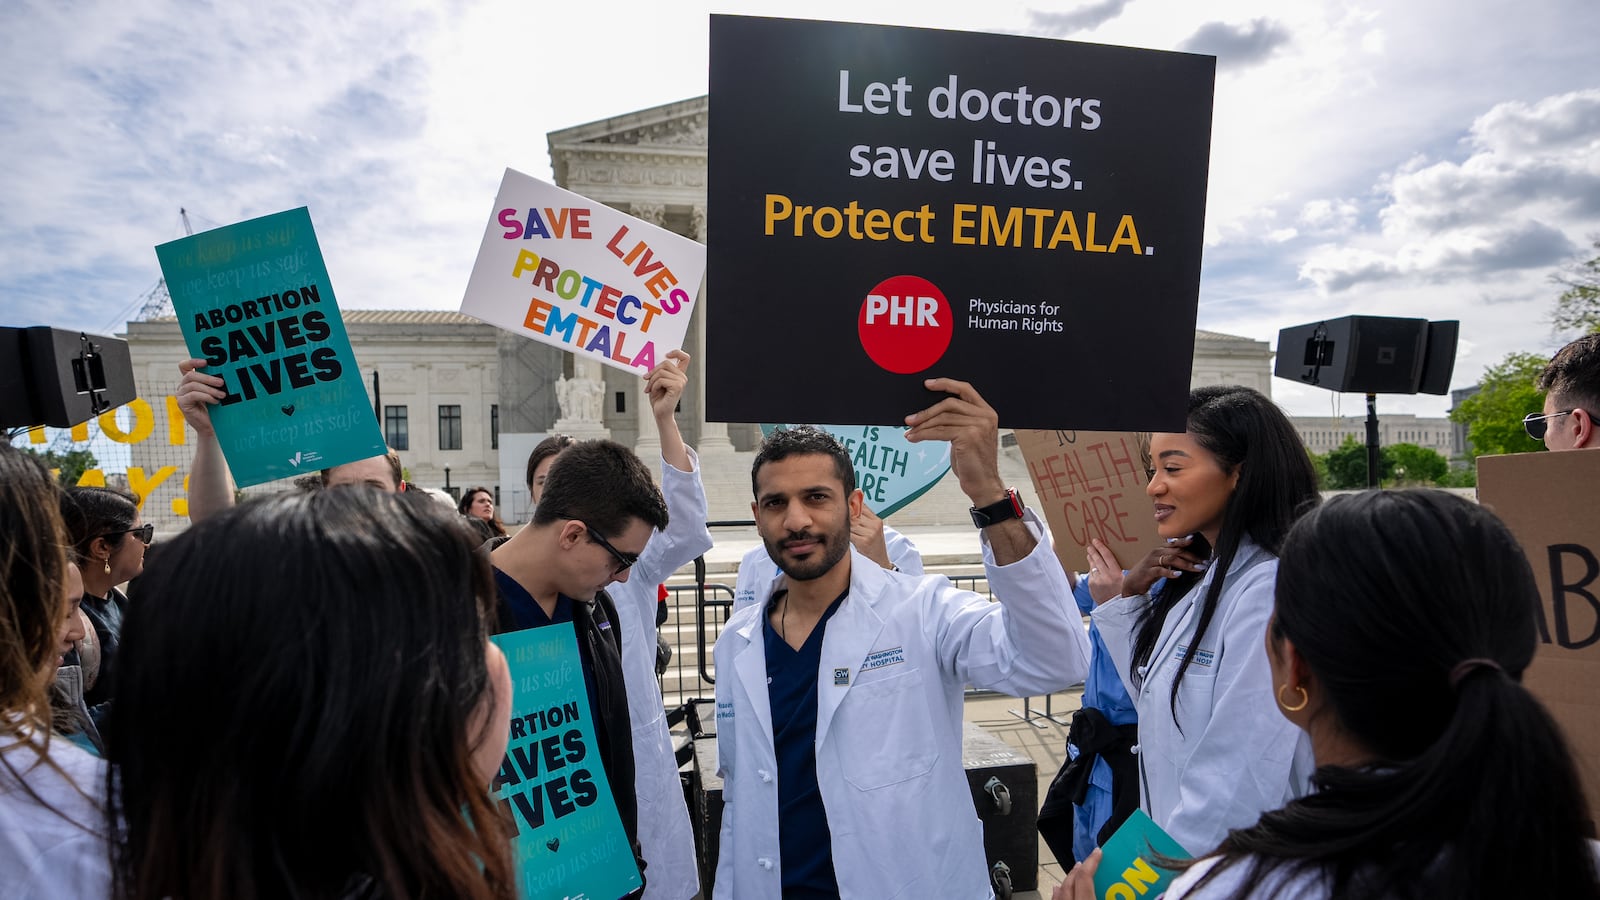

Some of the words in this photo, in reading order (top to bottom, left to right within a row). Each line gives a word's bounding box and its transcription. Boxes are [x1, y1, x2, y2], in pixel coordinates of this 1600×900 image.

[839, 70, 912, 117] Let
[928, 75, 1102, 131] doctors
[849, 144, 955, 182] save
[972, 140, 1083, 190] lives.
[498, 208, 592, 239] SAVE
[765, 194, 935, 243] Protect
[952, 204, 1154, 256] EMTALA.
[207, 266, 246, 289] keep
[249, 260, 271, 279] us
[275, 245, 310, 275] safe
[606, 225, 689, 315] LIVES
[194, 285, 321, 333] ABORTION
[512, 248, 662, 333] PROTECT
[866, 294, 939, 327] PHR
[969, 298, 1036, 317] Physicians
[1039, 301, 1060, 316] for
[200, 310, 330, 367] SAVES
[523, 297, 656, 374] EMTALA
[968, 316, 1018, 331] Human
[1021, 318, 1064, 335] Rights
[217, 347, 342, 407] LIVES
[260, 425, 299, 446] keep
[303, 419, 325, 437] us
[328, 403, 362, 432] safe
[863, 425, 880, 442] IS
[832, 433, 909, 477] EALTH
[1031, 438, 1140, 502] HEALTH
[1064, 493, 1138, 547] CARE
[521, 674, 540, 694] us
[543, 659, 573, 691] safe
[835, 670, 848, 678] GW
[871, 655, 904, 668] HOSPITAL
[492, 729, 587, 792] AVES
[569, 850, 590, 875] us
[591, 831, 619, 864] safe
